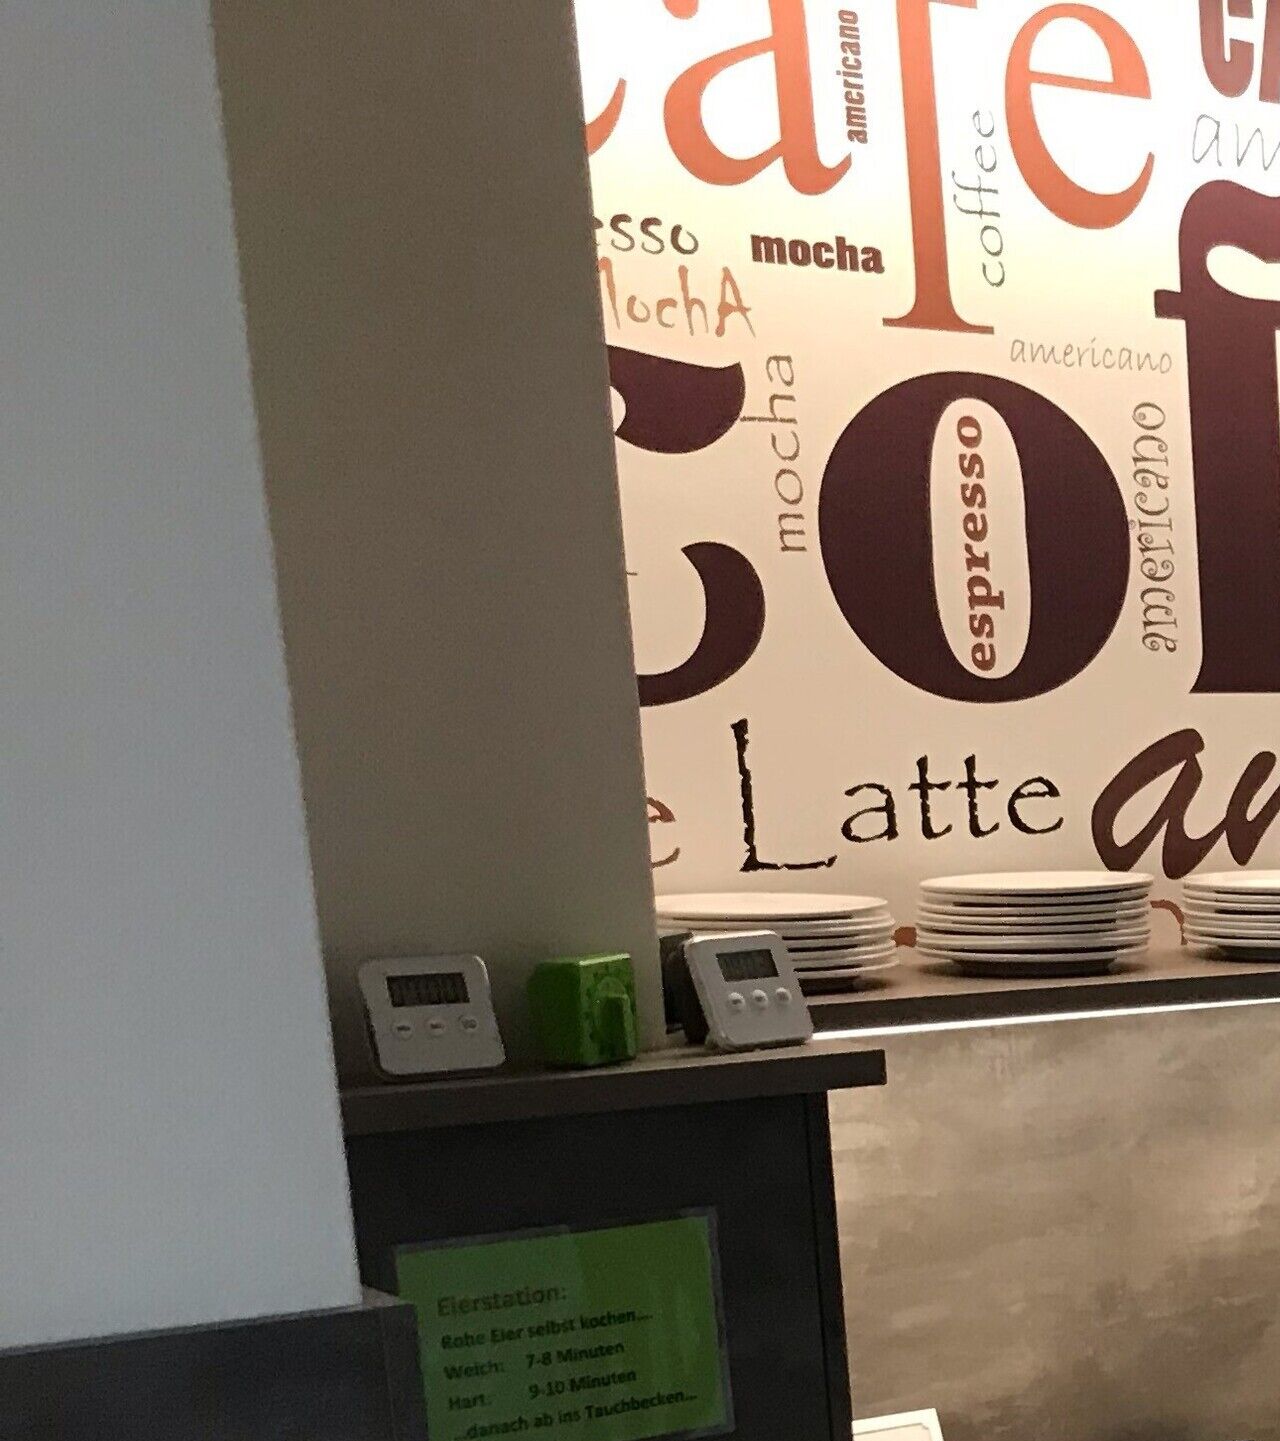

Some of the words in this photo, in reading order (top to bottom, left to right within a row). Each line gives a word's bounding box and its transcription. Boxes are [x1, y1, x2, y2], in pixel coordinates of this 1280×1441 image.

[835, 9, 868, 144] americano
[585, 0, 1155, 335] afe
[952, 109, 1006, 288] coffee
[750, 234, 885, 274] mocha
[1010, 338, 1173, 375] americano
[740, 354, 807, 553] mocha
[957, 414, 1005, 671] espresso
[1129, 401, 1179, 653] americano
[729, 718, 1065, 872] Latte
[437, 1285, 567, 1318] Eierstation:
[441, 1332, 486, 1350] Rohe
[490, 1327, 523, 1344] Eier
[527, 1317, 576, 1339] selbst
[526, 1351, 552, 1369] 7-8
[557, 1341, 625, 1364] Minuten
[529, 1381, 565, 1400] 9-10
[570, 1369, 637, 1393] Minuten
[534, 1409, 553, 1428] ab
[558, 1407, 582, 1425] ins
